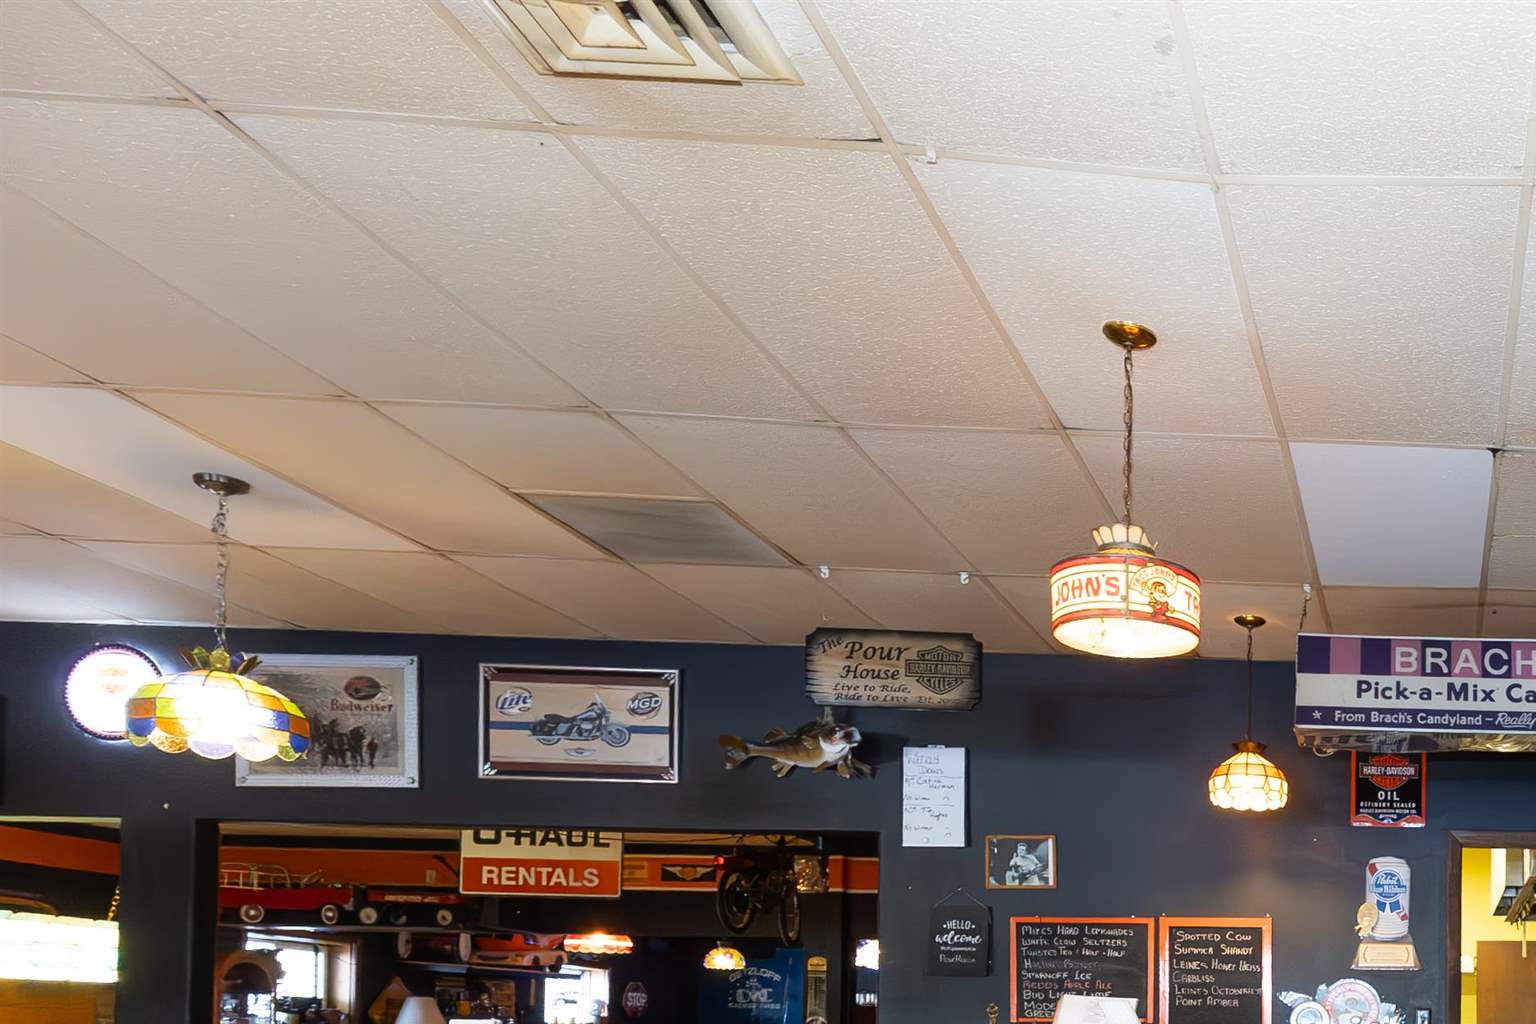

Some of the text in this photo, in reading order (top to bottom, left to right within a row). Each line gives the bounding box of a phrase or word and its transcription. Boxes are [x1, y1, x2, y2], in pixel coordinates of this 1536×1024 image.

[1055, 574, 1120, 607] JOHN'S
[818, 636, 911, 662] The Pour
[840, 662, 900, 681] House
[832, 682, 860, 692] Live
[864, 684, 876, 692] to
[1356, 679, 1496, 703] Pick-a-Mix
[626, 695, 663, 712] MGD
[834, 692, 909, 703] Ride to Live
[329, 698, 395, 714] Budweiser
[1334, 710, 1366, 723] From
[1370, 711, 1413, 724] Brach's
[1416, 712, 1482, 727] Candyland
[1495, 713, 1536, 730] Really
[1362, 766, 1415, 776] HARLEY-DAVIDSON
[1377, 791, 1400, 801] OIL
[481, 865, 600, 887] RENTALS
[946, 919, 972, 930] HELLO
[935, 930, 983, 945] welcome
[1176, 930, 1252, 942] SPOTTED COW
[1174, 944, 1254, 956] SUMMER SHANDY
[1074, 971, 1093, 980] ICE
[626, 992, 648, 1006] STOP
[1023, 990, 1045, 1000] BUD
[1175, 995, 1240, 1007] POINT AMBER
